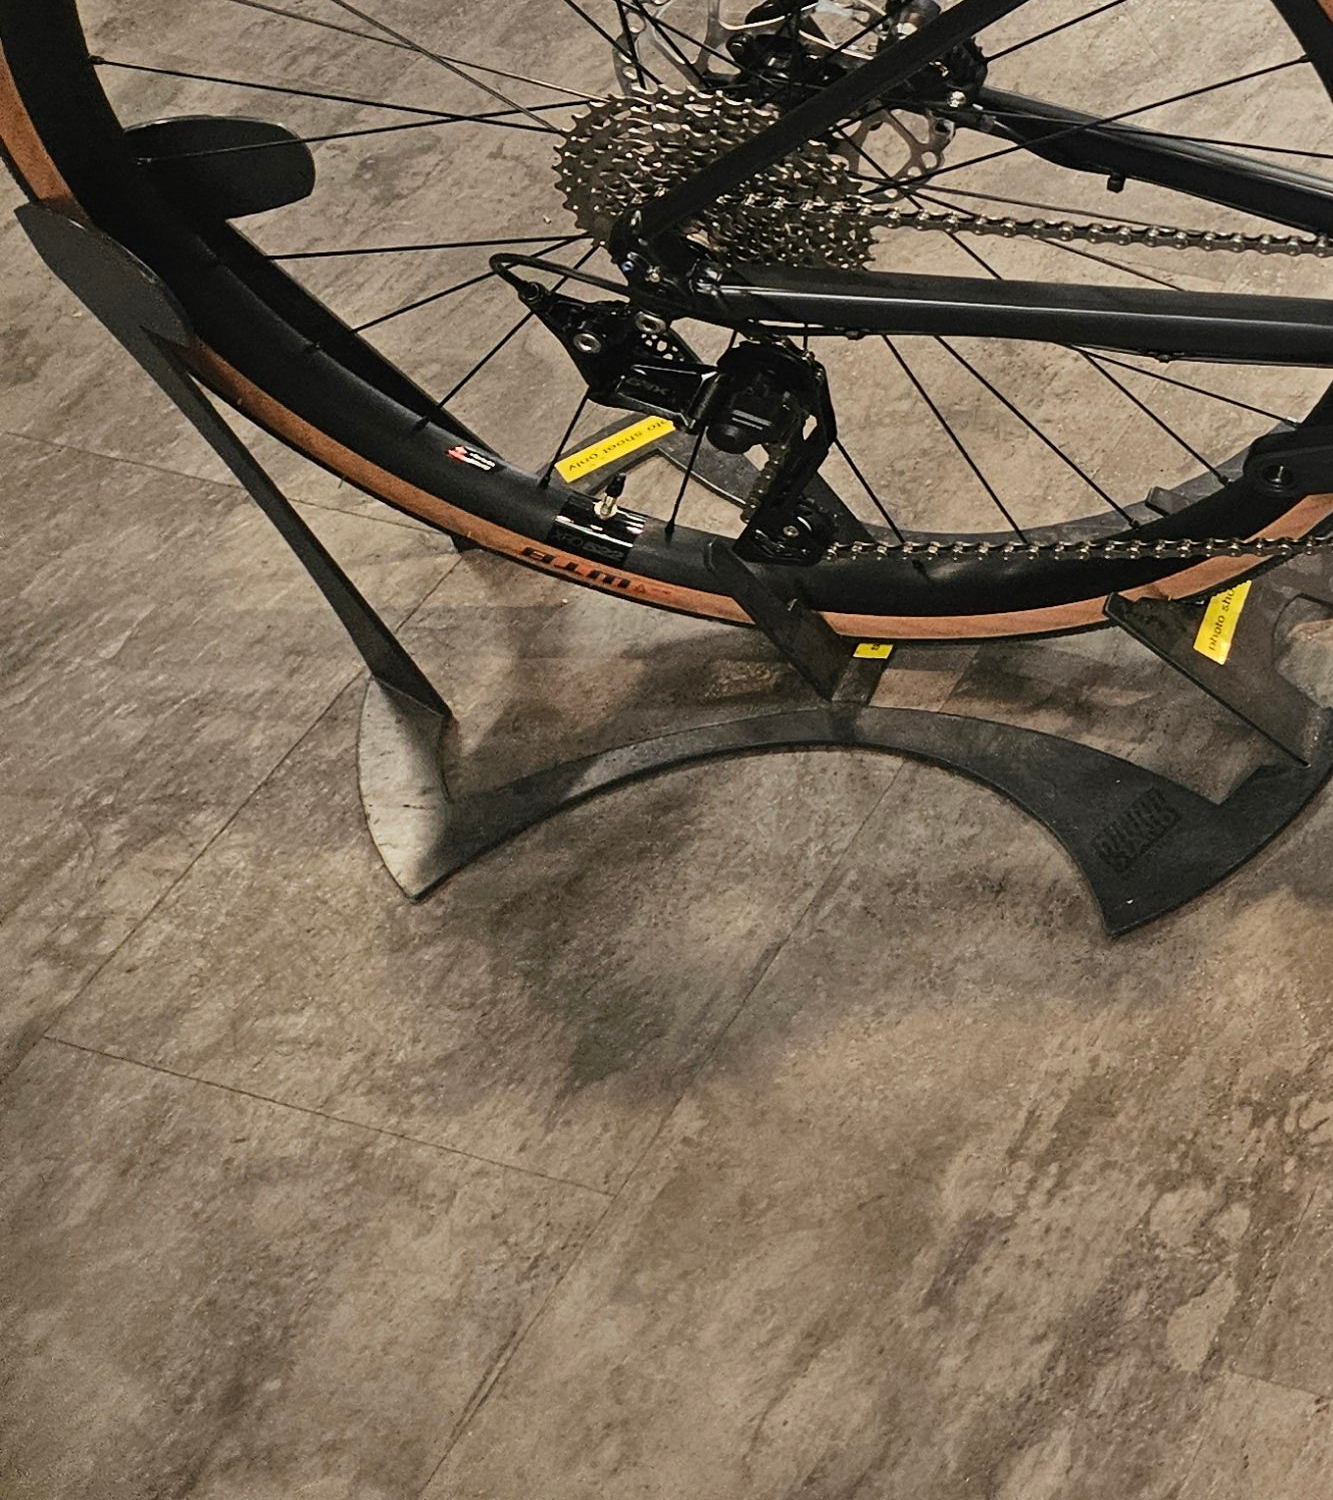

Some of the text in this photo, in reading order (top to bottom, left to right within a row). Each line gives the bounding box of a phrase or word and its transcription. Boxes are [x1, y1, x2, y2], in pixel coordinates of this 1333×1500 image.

[602, 432, 643, 454] shoot
[568, 453, 598, 472] only
[519, 546, 632, 590] WTB
[1206, 587, 1238, 652] photo sho
